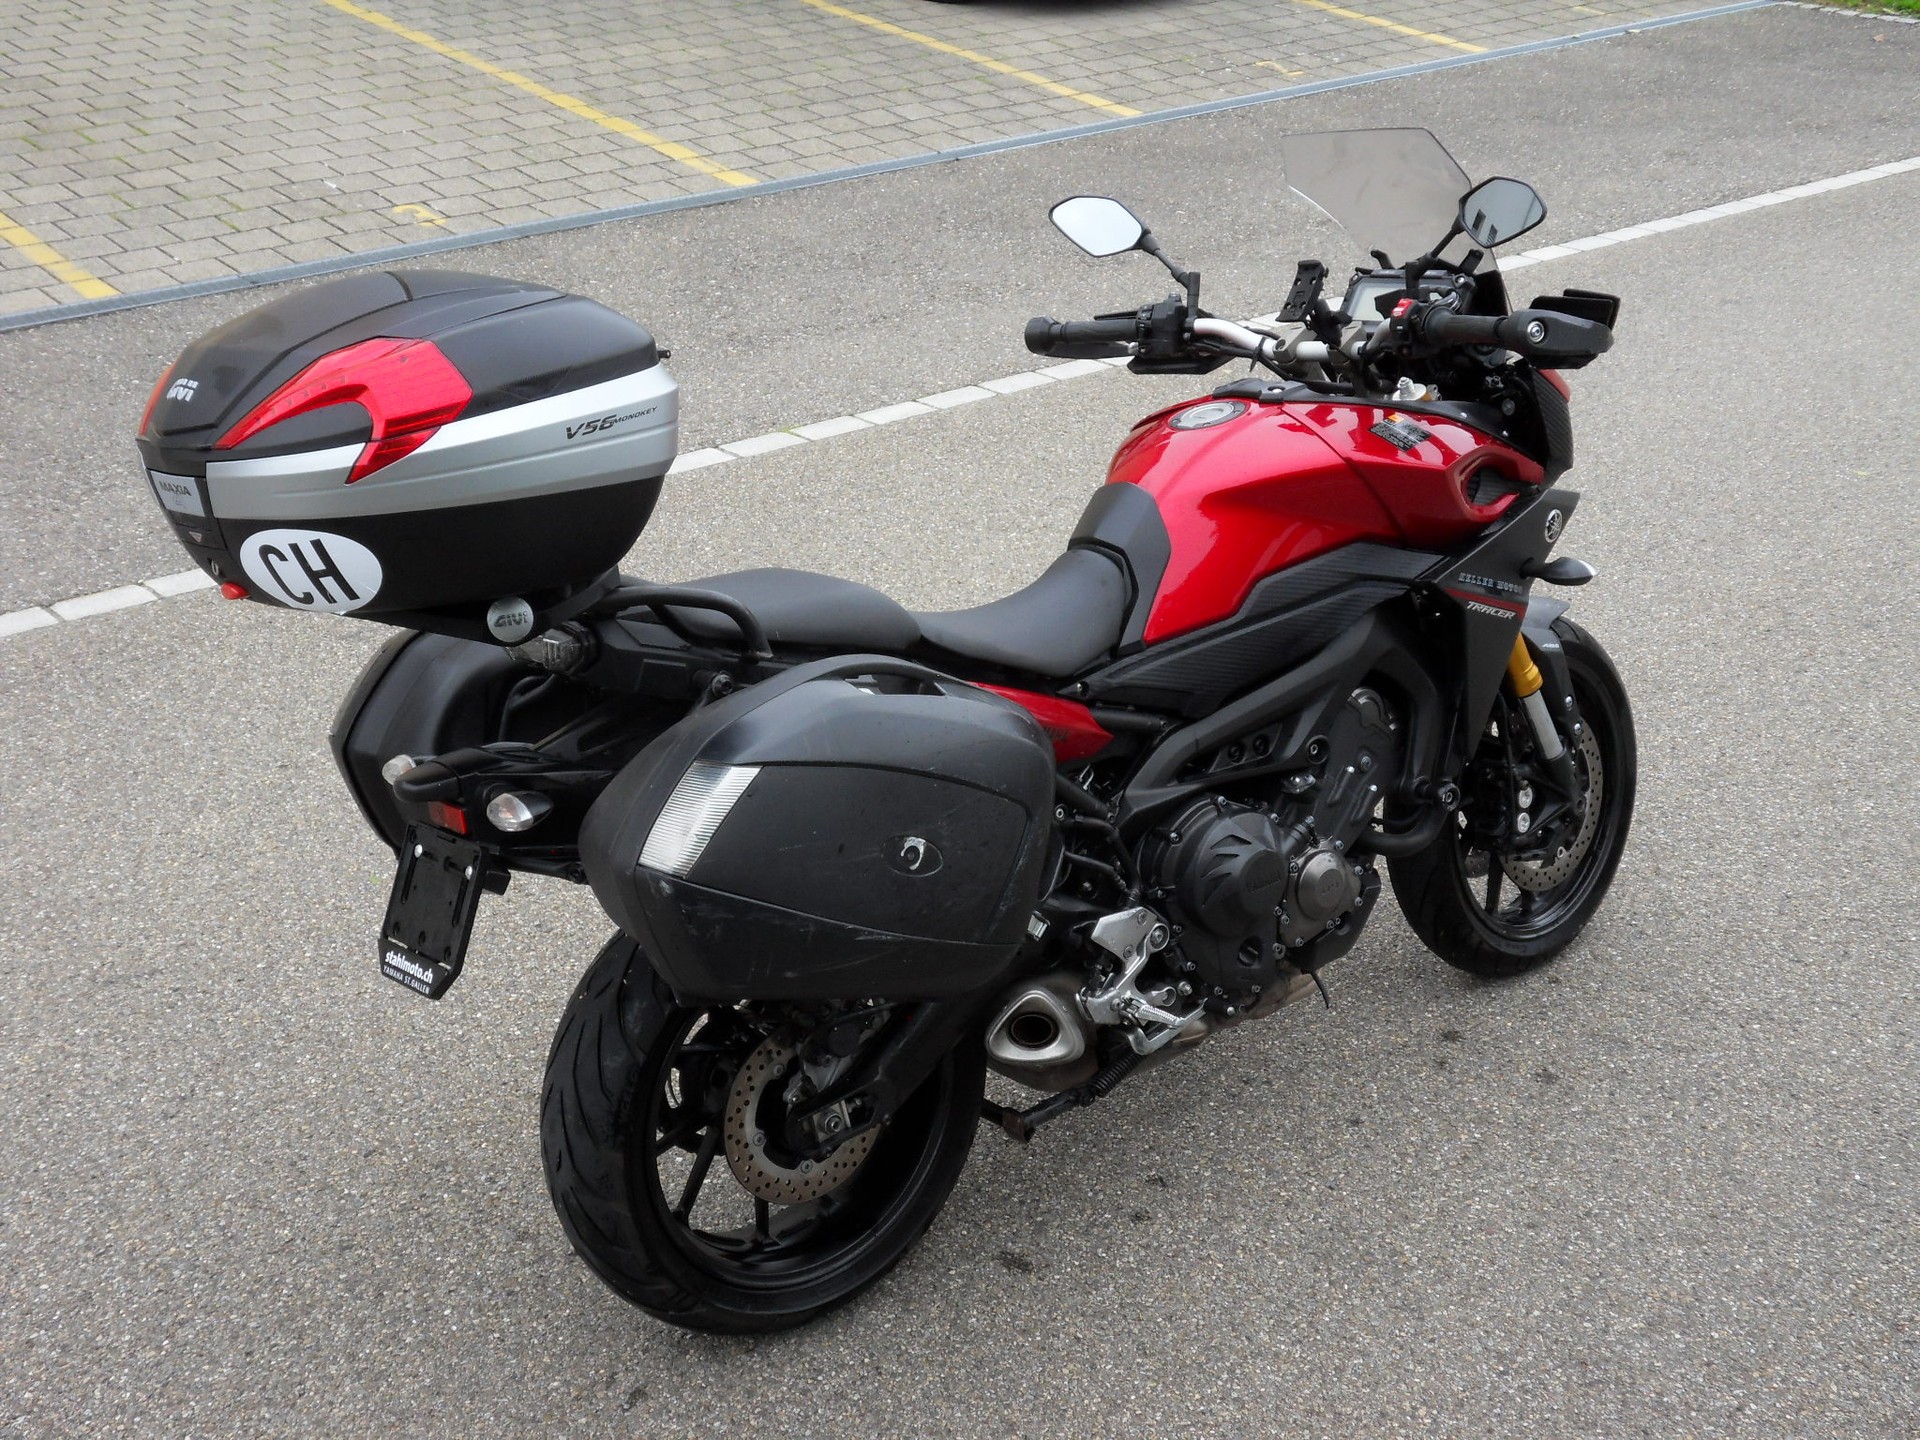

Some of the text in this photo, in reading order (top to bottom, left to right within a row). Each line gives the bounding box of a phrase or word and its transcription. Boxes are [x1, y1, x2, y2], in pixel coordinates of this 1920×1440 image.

[566, 406, 658, 440] V56 MONOKEY
[158, 480, 192, 497] MAXIA
[258, 538, 360, 605] CH
[1467, 601, 1517, 619] TRACER
[383, 965, 403, 980] YAMAHA
[385, 951, 433, 983] stahlmoto.ch
